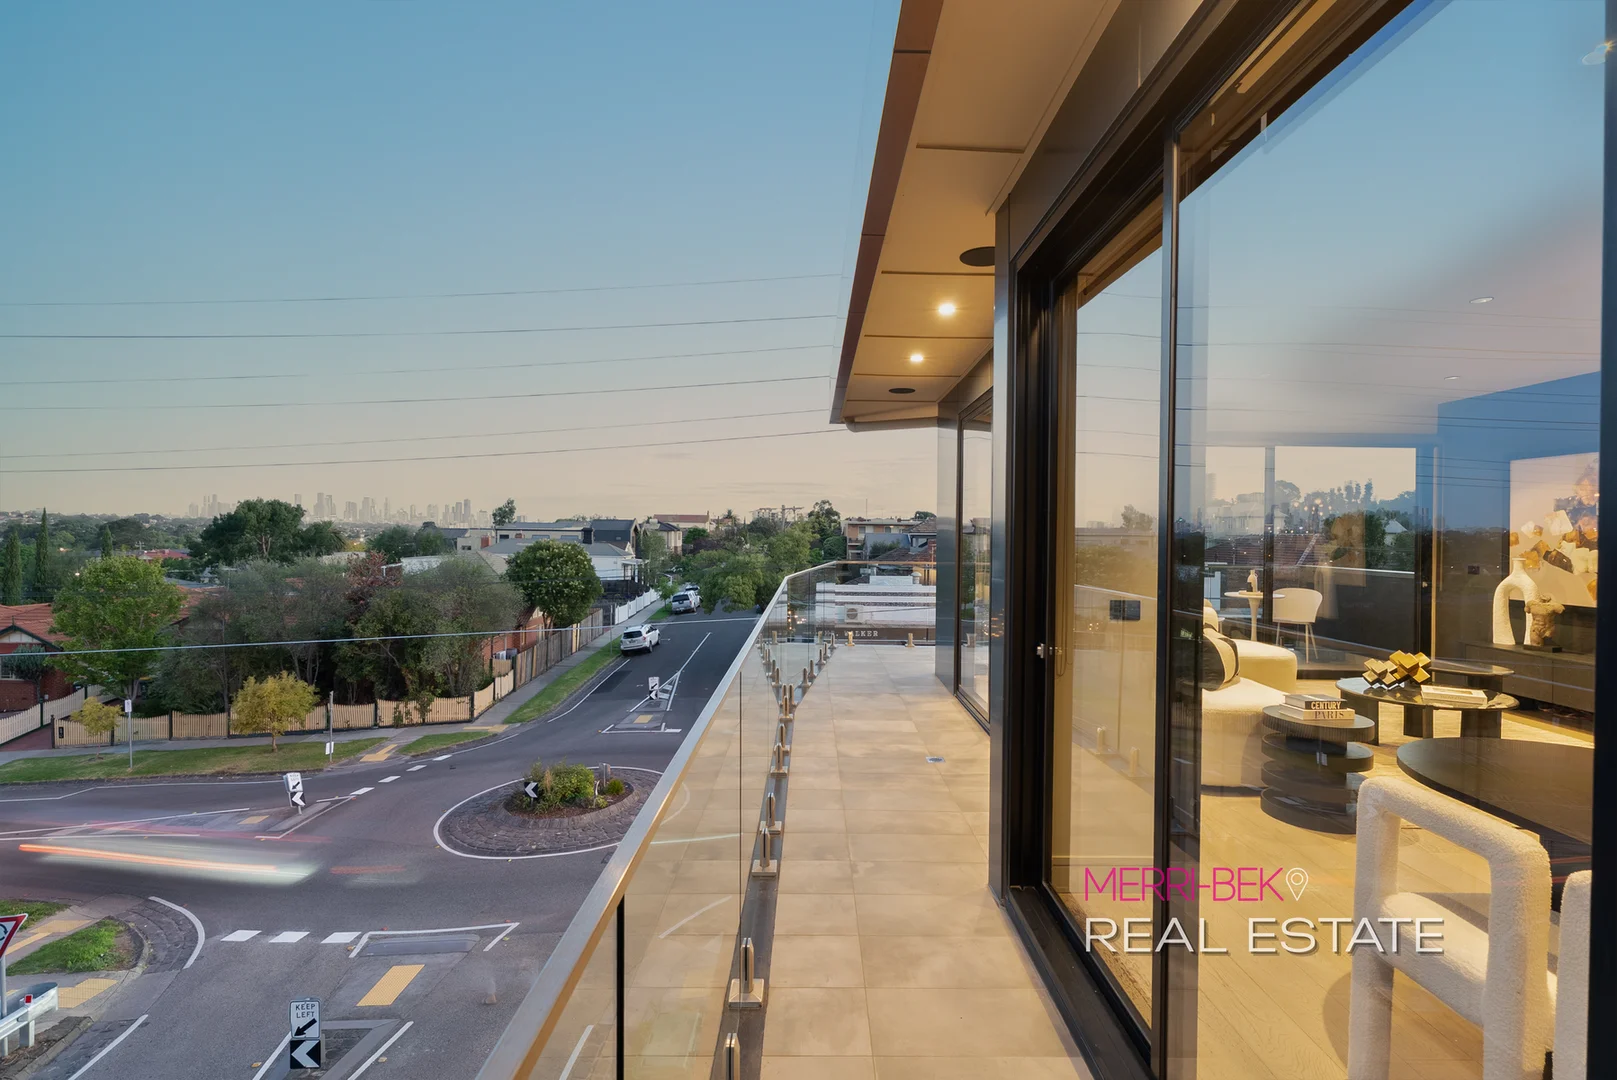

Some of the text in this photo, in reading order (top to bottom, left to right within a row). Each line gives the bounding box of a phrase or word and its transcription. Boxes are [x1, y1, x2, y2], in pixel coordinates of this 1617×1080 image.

[1311, 701, 1341, 710] CENTURY
[1314, 711, 1344, 719] PARIS
[295, 1003, 316, 1011] KEEP
[296, 1011, 315, 1019] LEFT
